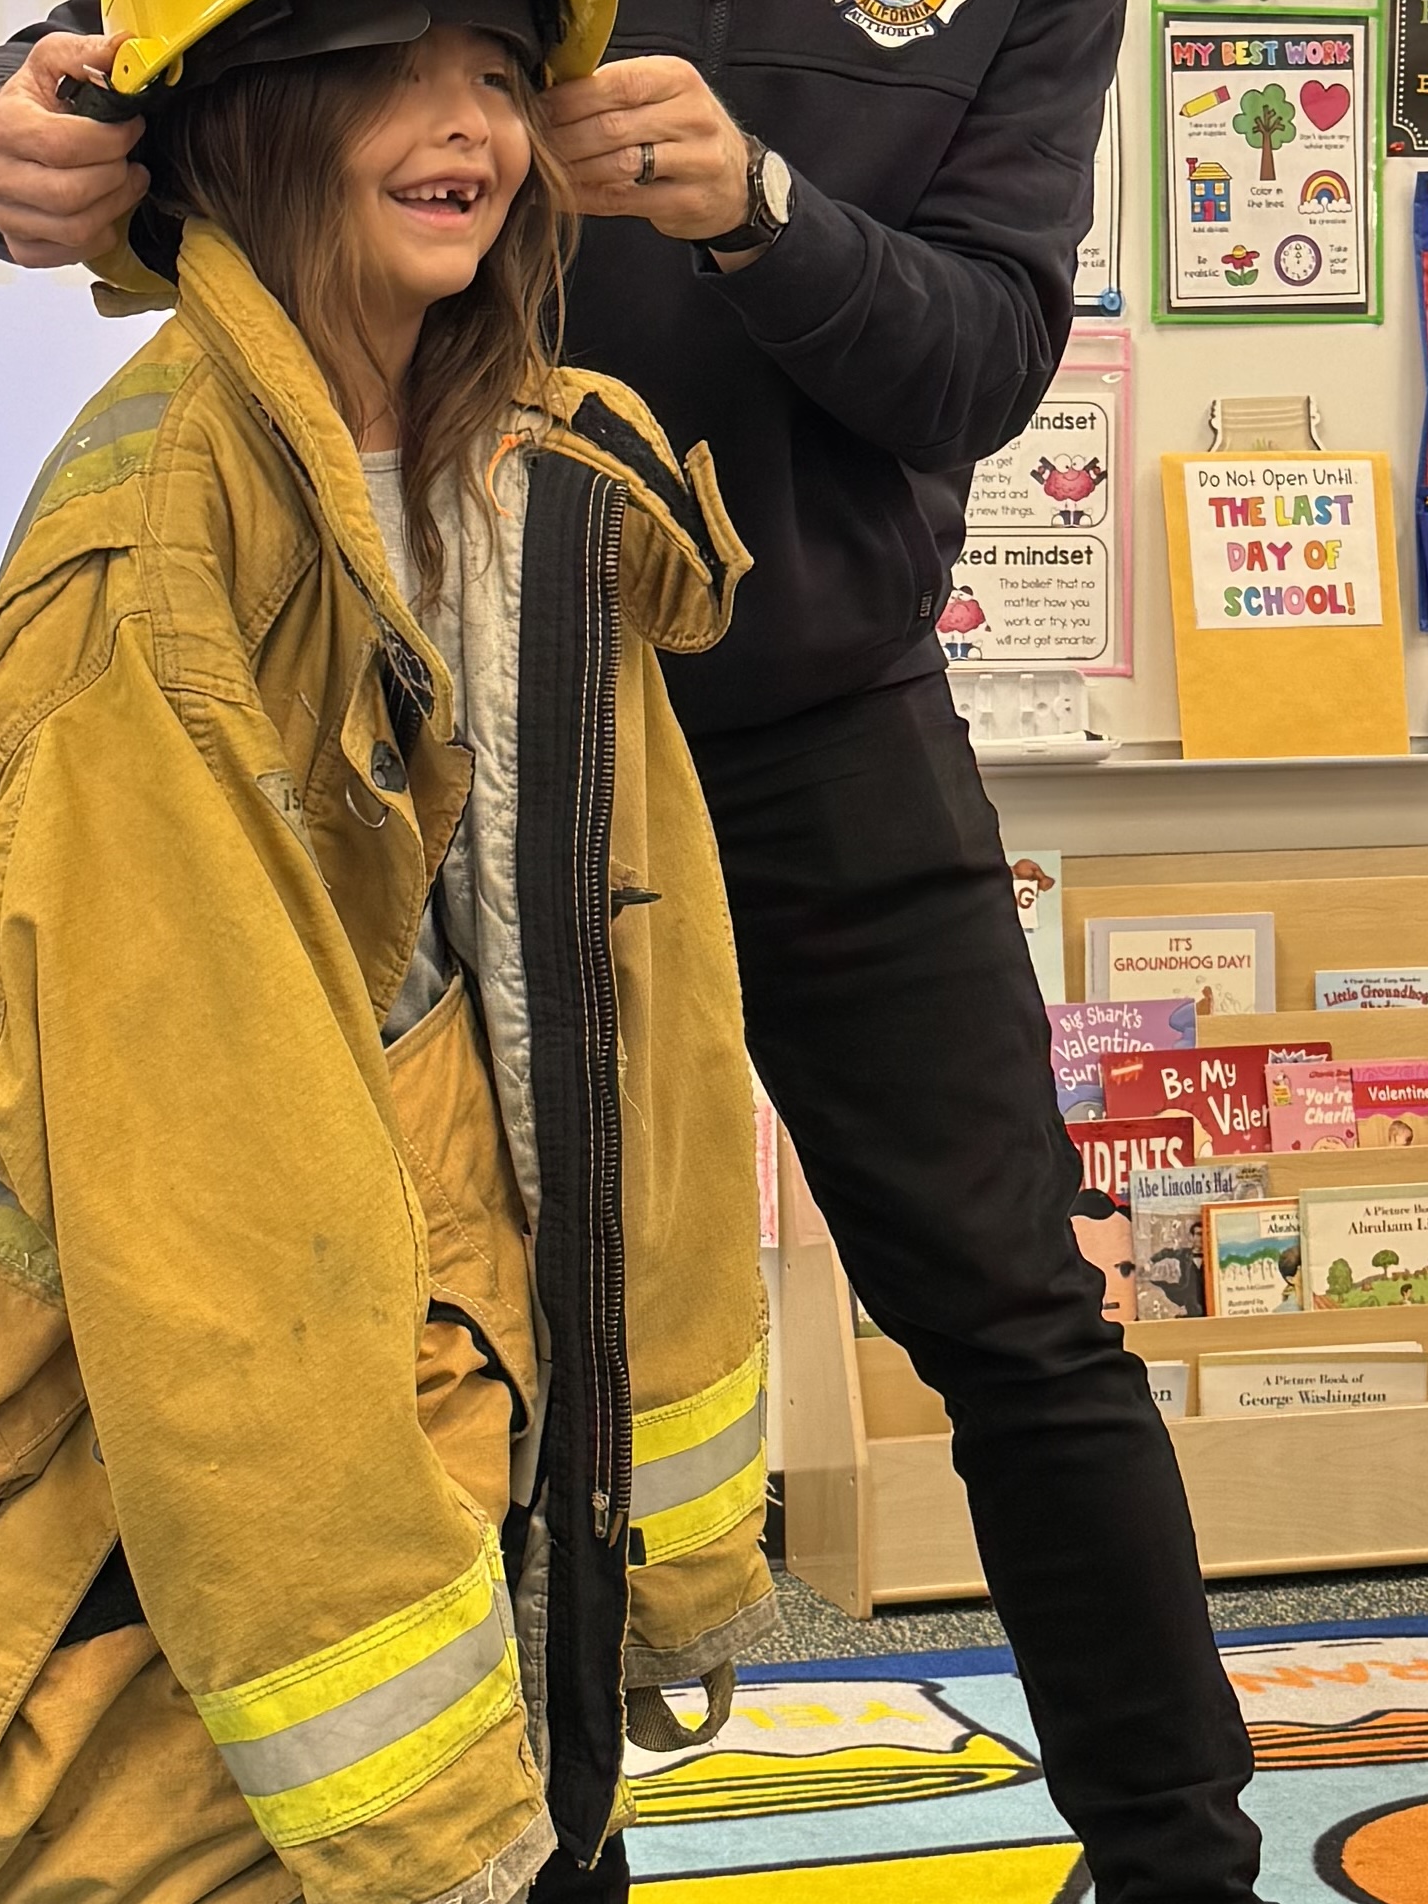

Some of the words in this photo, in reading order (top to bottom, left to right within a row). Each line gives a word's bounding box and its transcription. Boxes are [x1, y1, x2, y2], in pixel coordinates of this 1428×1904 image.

[848, 10, 929, 37] AUTHORITY
[1174, 42, 1214, 66] MY
[1222, 41, 1278, 65] BEST
[1285, 41, 1351, 65] WORK
[1199, 470, 1220, 487] Do
[1227, 472, 1256, 487] Not
[1263, 470, 1307, 491] Open
[1208, 497, 1265, 527] THE
[1275, 495, 1353, 526] LAST
[1005, 545, 1093, 565] mindset
[1227, 541, 1293, 571] DAY
[1303, 540, 1342, 570] OF
[1224, 582, 1355, 617] SCHOOL!
[1169, 938, 1192, 952] IT'S
[1114, 955, 1214, 971] GROUNDHOG
[1218, 956, 1251, 969] DAY!
[1060, 1011, 1083, 1032] Big
[1087, 1005, 1142, 1029] Shark's
[1161, 1068, 1194, 1100] Be
[1201, 1059, 1236, 1092] My
[1138, 1176, 1159, 1197] Abe
[1161, 1174, 1210, 1196] Lincoln's
[1214, 1172, 1233, 1193] Hat
[1348, 1219, 1413, 1235] Abraham
[1239, 1390, 1293, 1408] George
[1299, 1388, 1386, 1405] Washington
